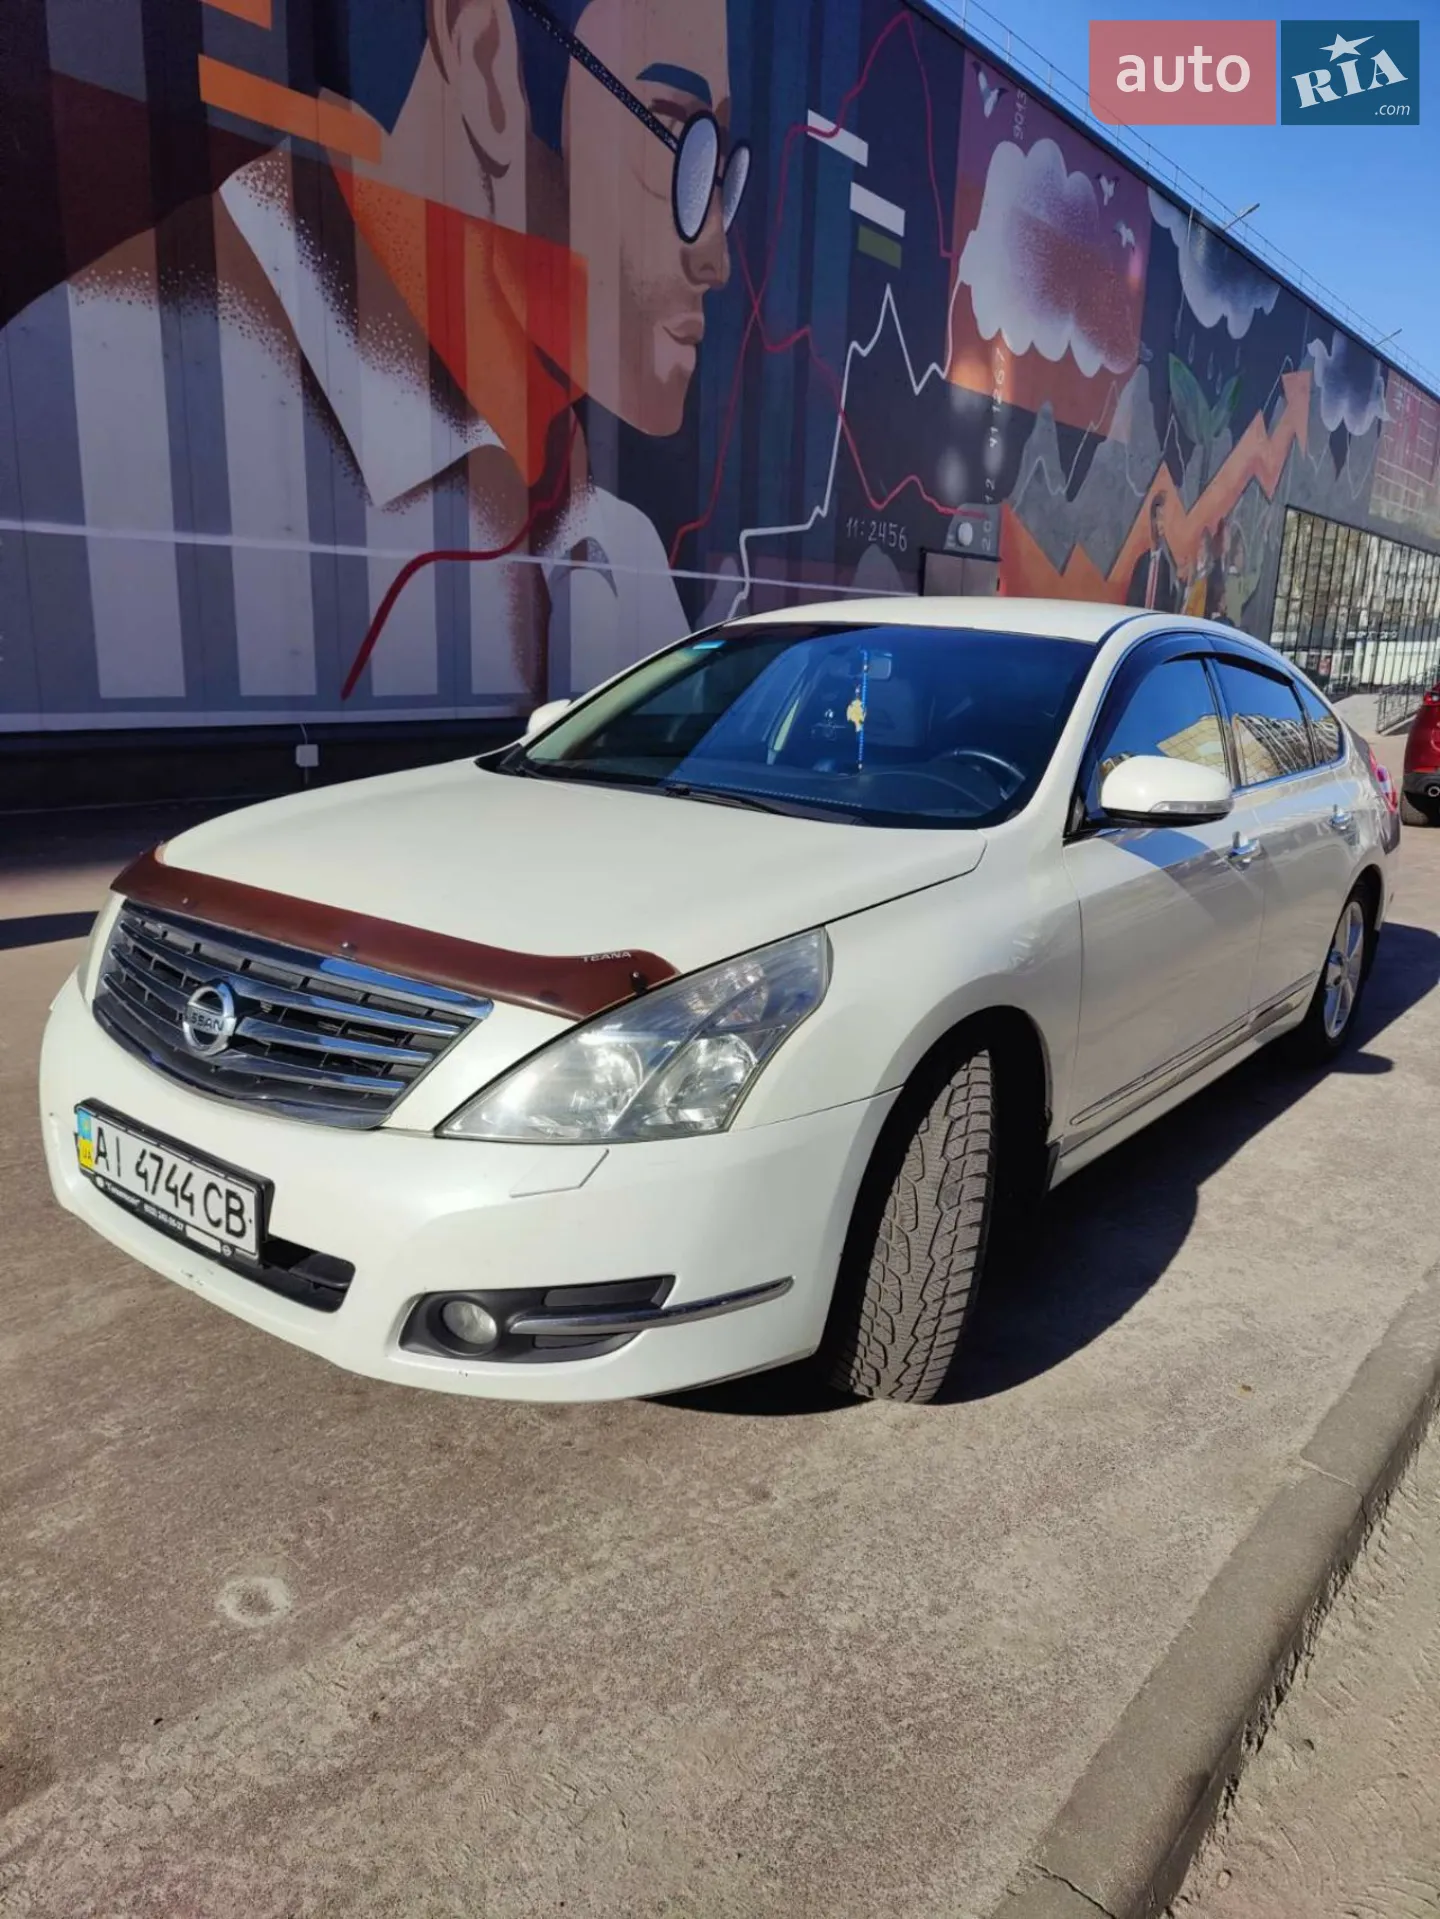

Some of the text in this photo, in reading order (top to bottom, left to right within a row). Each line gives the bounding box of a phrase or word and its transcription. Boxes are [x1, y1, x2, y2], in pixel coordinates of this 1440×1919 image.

[581, 951, 632, 962] TEANA
[187, 1009, 224, 1032] SSAN
[95, 1126, 121, 1177] AI
[135, 1149, 195, 1218] 4744
[203, 1182, 247, 1239] CB
